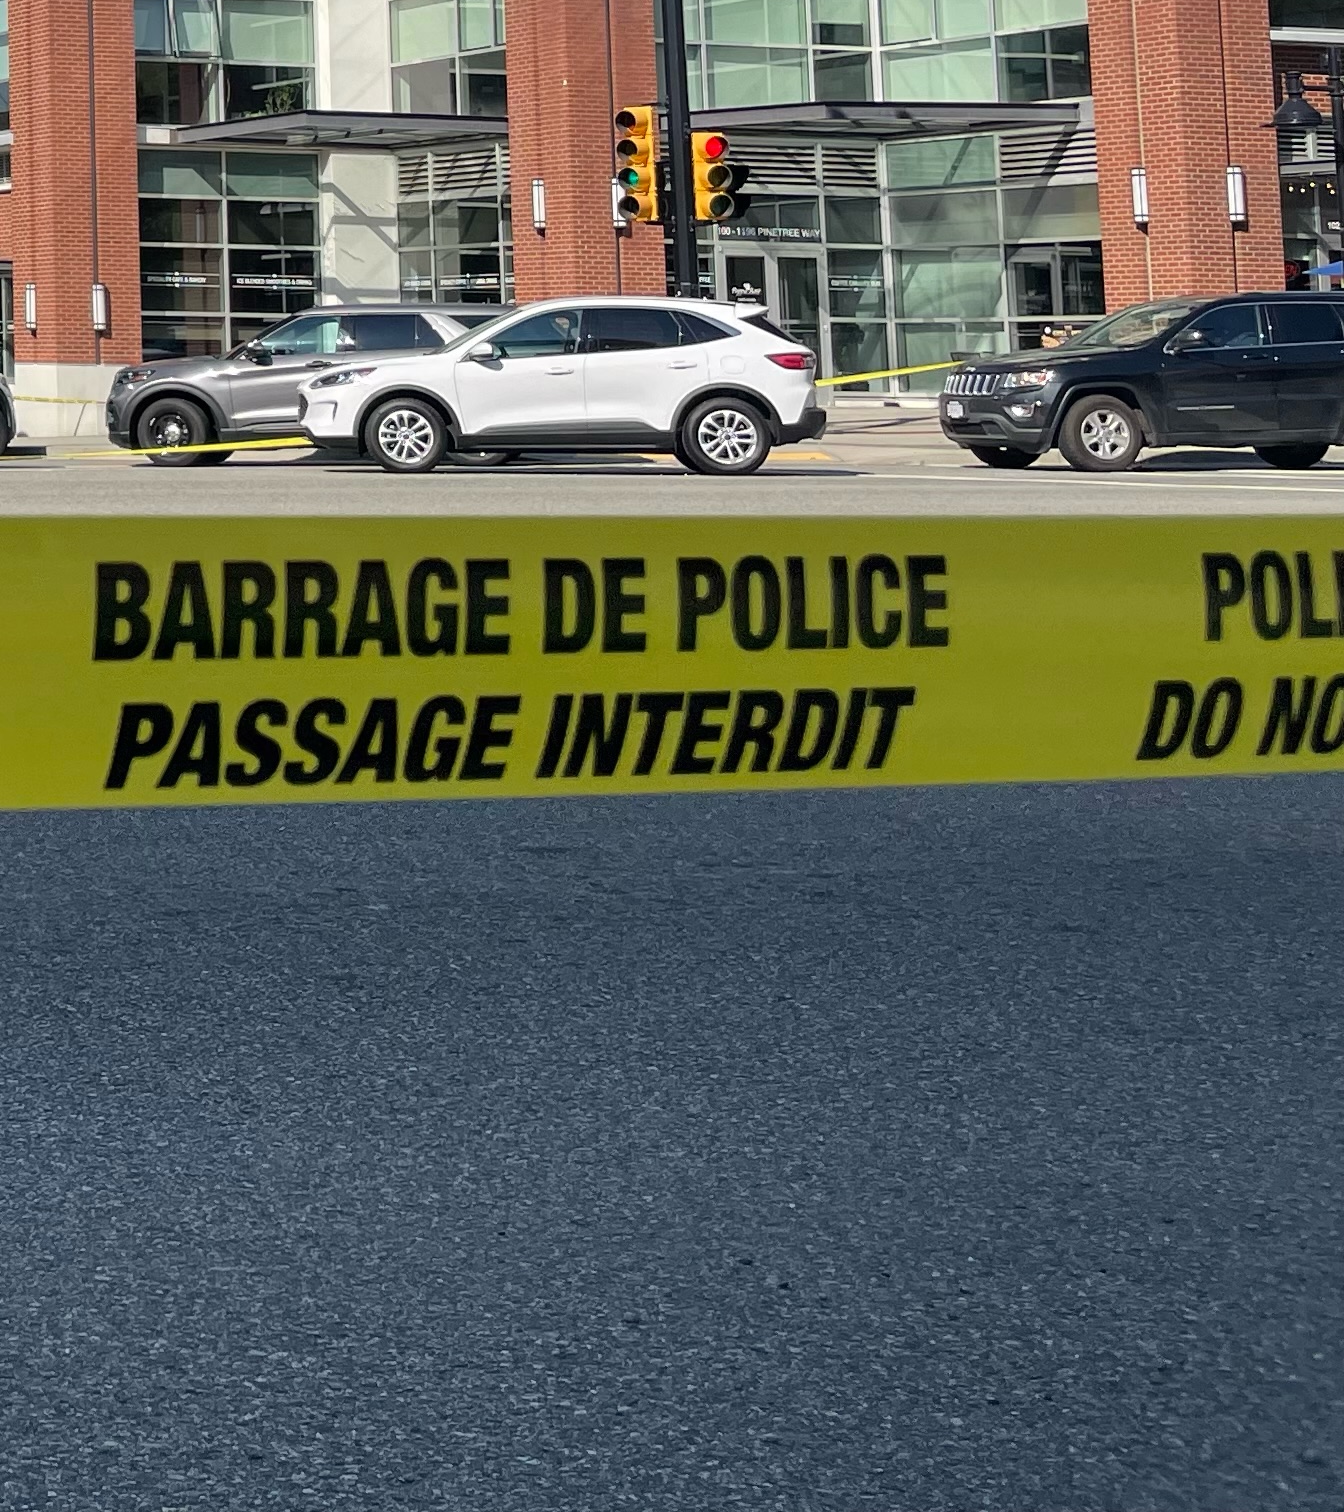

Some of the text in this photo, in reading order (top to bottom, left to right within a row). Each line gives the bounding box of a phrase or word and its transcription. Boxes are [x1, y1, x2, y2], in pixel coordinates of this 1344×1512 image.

[757, 227, 800, 237] PINETREE
[801, 228, 820, 238] WAY
[91, 552, 951, 663] BARRAGE DE POLICE
[103, 685, 918, 792] PASSAGE INTERDIT
[1135, 675, 1245, 762] DO
